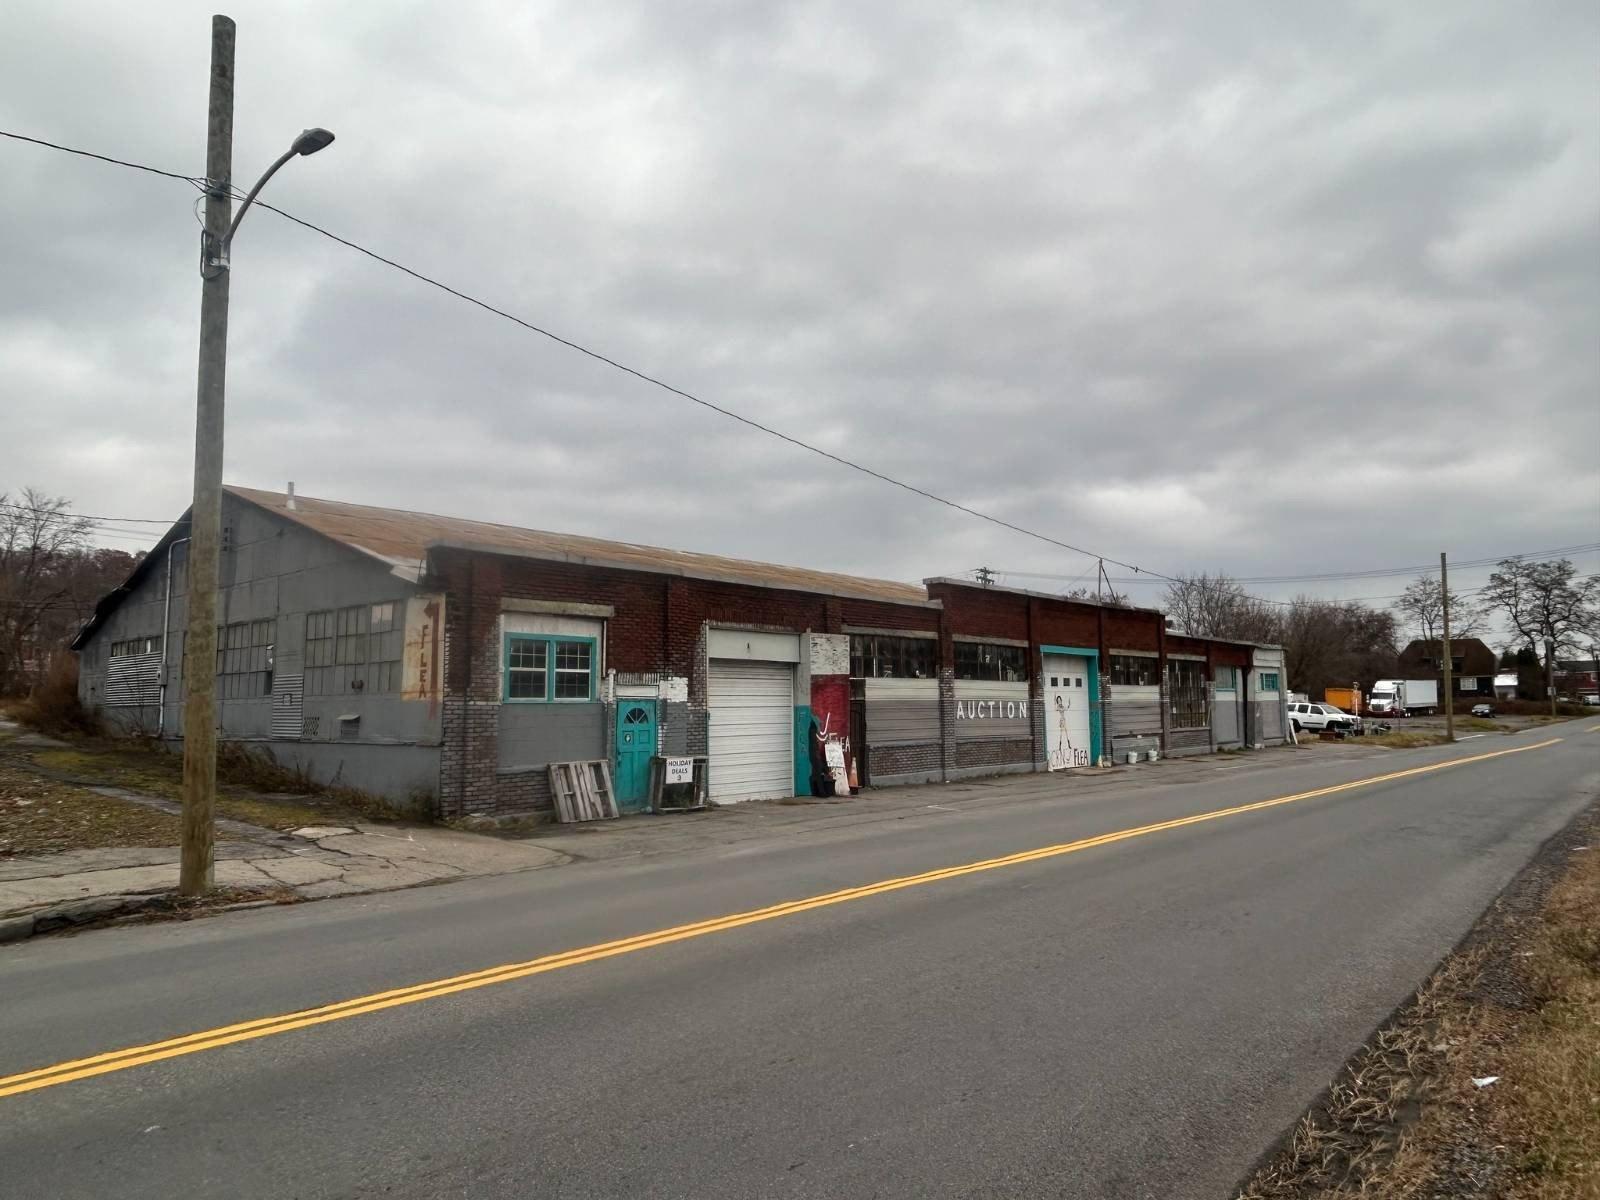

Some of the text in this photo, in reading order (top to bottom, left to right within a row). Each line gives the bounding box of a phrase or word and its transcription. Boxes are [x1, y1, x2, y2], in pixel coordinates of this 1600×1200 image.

[418, 624, 428, 699] FLEA
[956, 700, 1027, 719] AUCTION
[1073, 748, 1089, 766] FLEA
